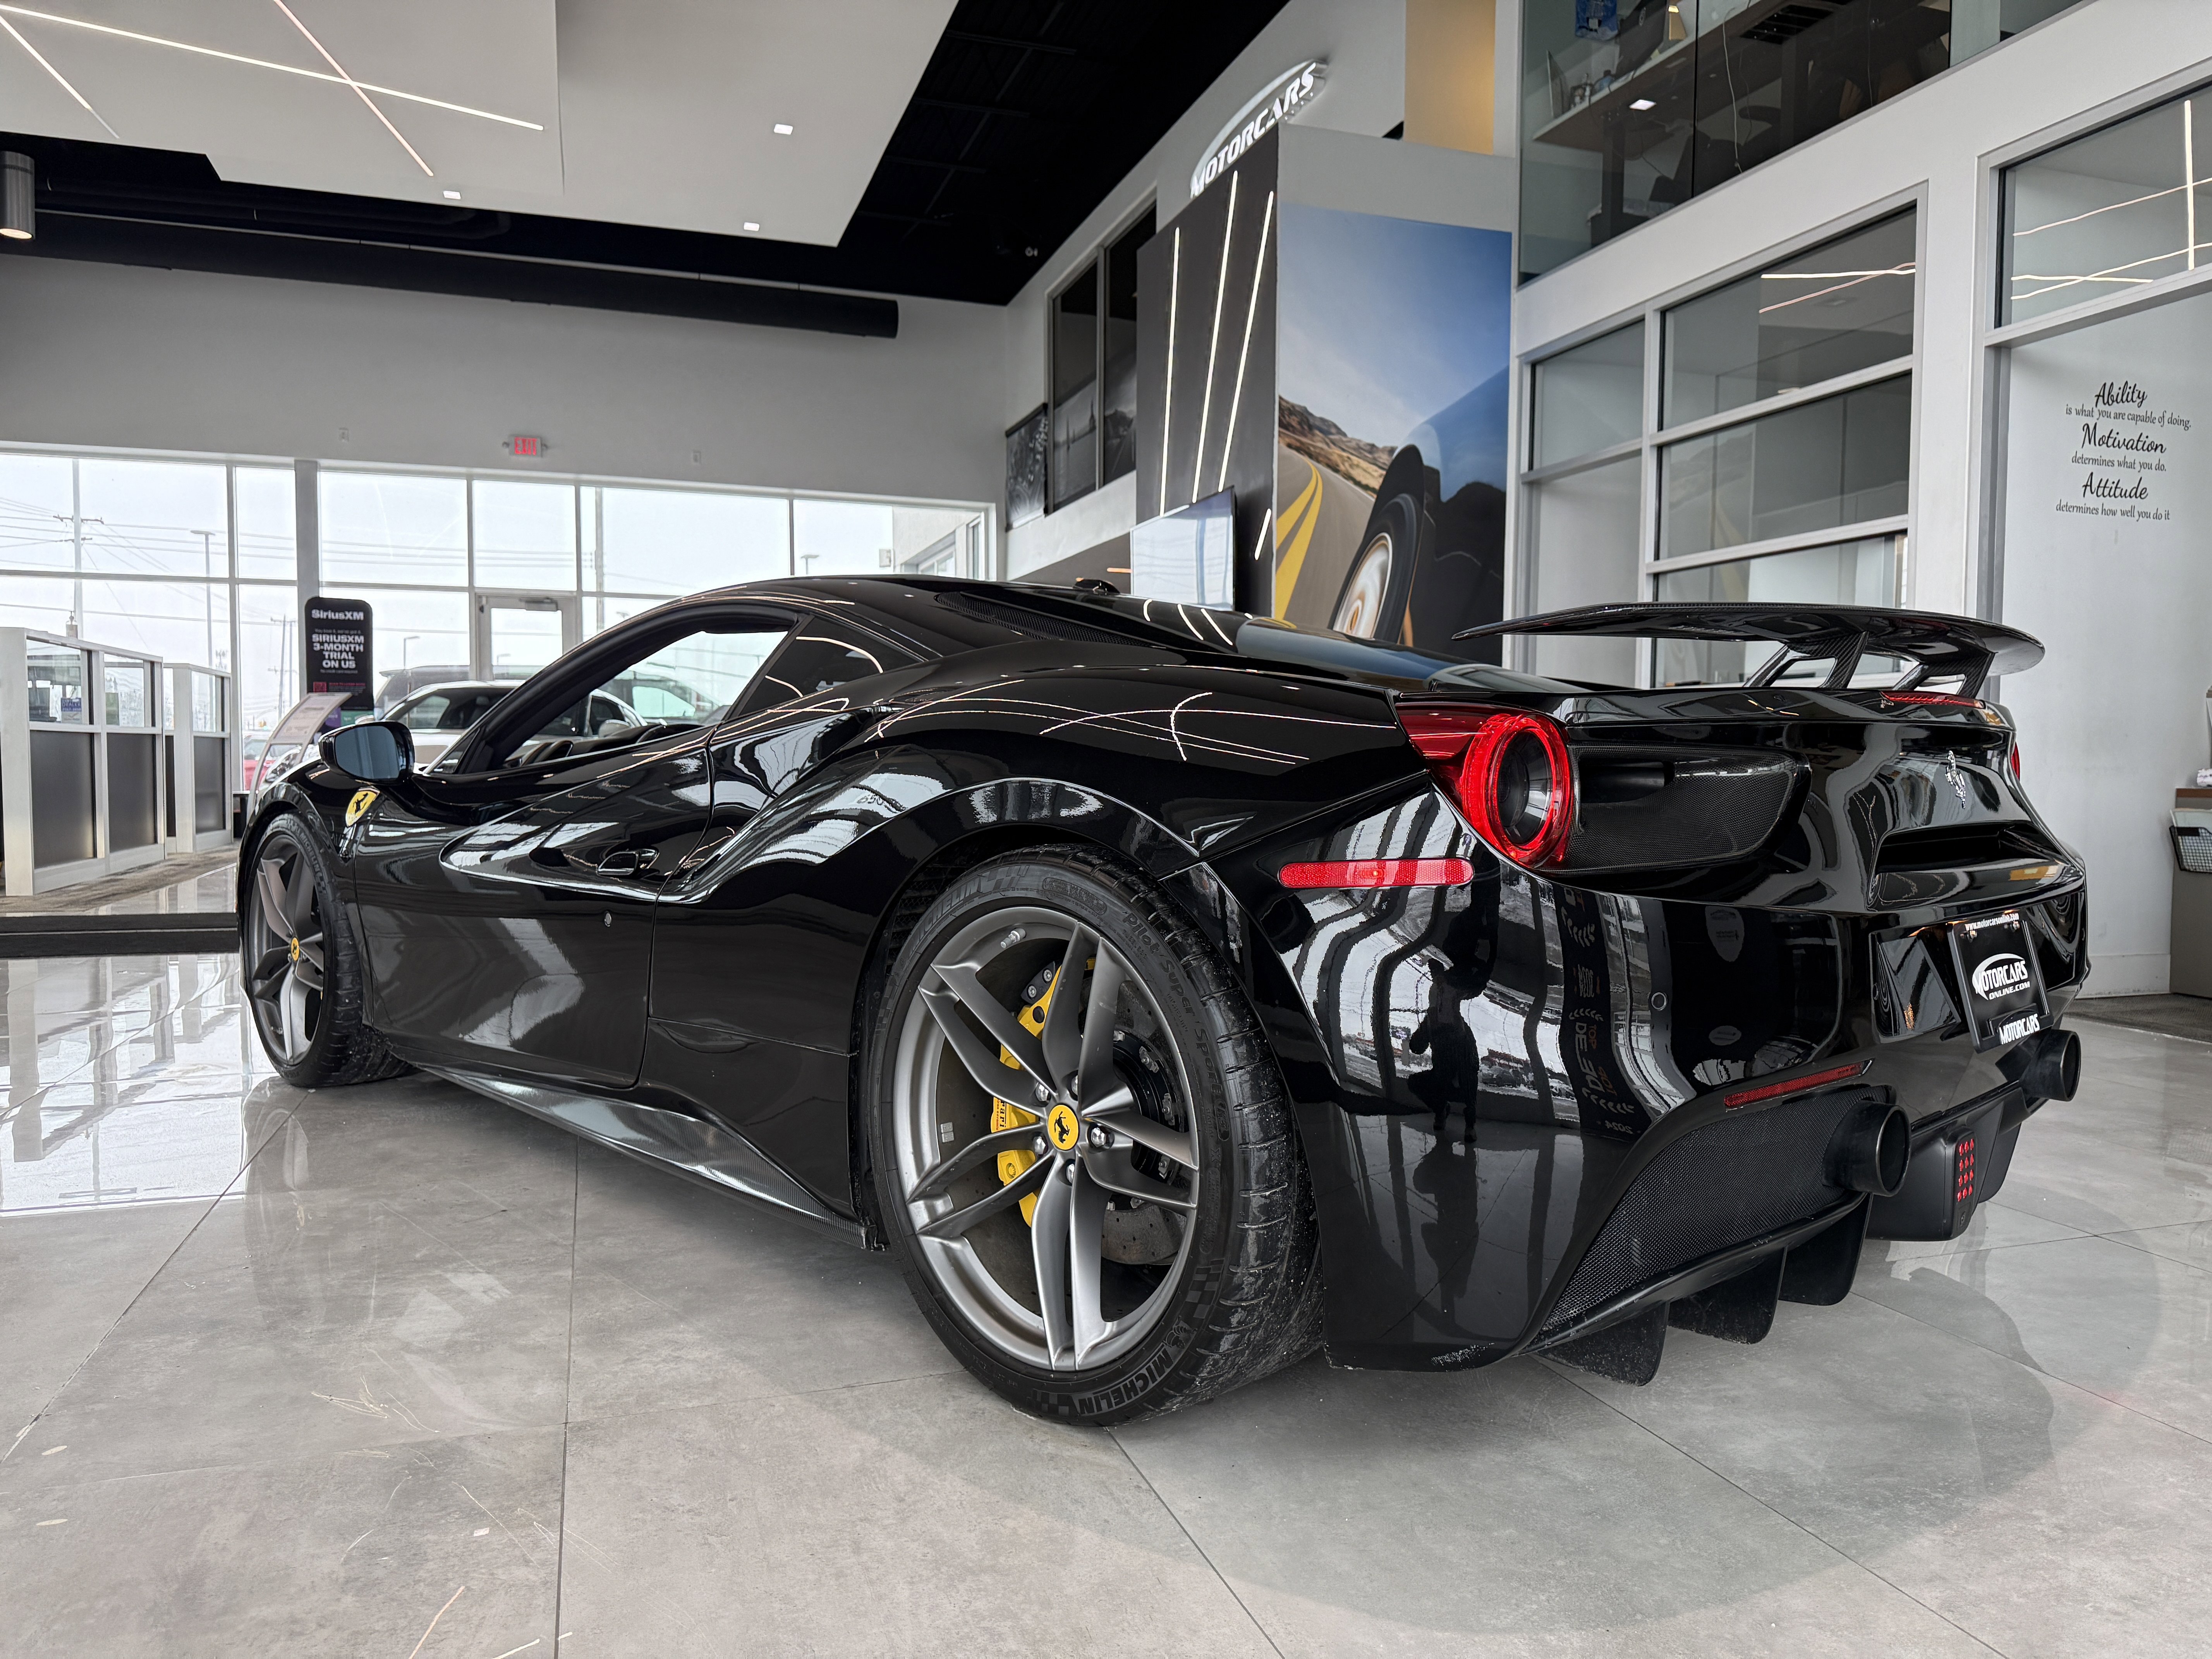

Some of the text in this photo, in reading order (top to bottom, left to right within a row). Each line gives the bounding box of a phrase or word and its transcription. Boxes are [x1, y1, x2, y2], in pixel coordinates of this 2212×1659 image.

[1190, 62, 1316, 199] MOTORCARS
[2095, 381, 2147, 408] Ability
[2066, 404, 2191, 431] is what you are capable of doing.
[514, 437, 538, 455] EXIT
[2082, 422, 2167, 453] Motivation
[2072, 451, 2167, 472] determines what you do.
[2082, 472, 2148, 500] Attitude
[2056, 499, 2170, 522] determines how well you do it
[311, 609, 364, 620] SiriusXM
[312, 634, 364, 644] SIRIUSXM
[313, 643, 364, 652] 3-MONTH
[323, 651, 355, 660] TRIAL
[323, 660, 356, 669] ON US
[300, 832, 320, 872] MICHELIN
[909, 877, 981, 957] MICHELIN
[1123, 913, 1160, 954] Pilot
[1160, 960, 1196, 1017] Super
[1975, 960, 2028, 994] MOTORCARS
[1989, 981, 2030, 1000] ONLINE.COM
[1999, 1013, 2040, 1045] MOTORCARS
[1079, 1348, 1174, 1415] MICHELIN
